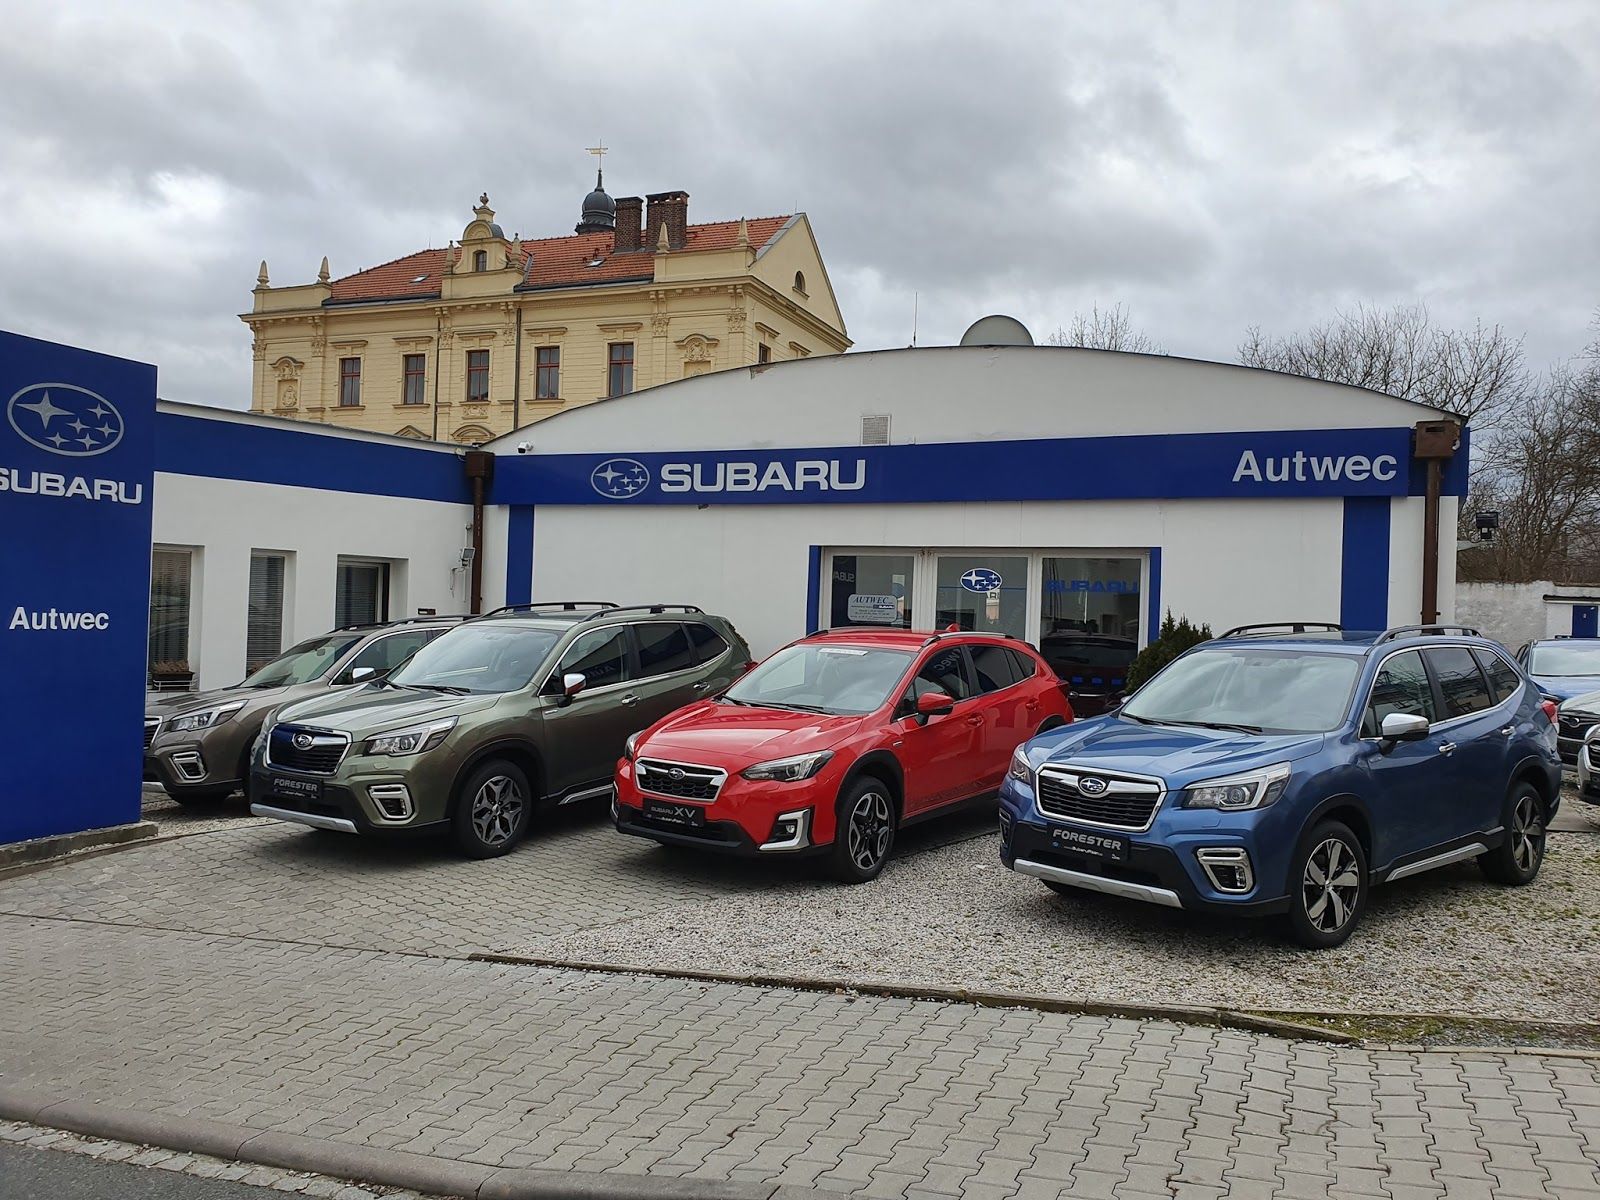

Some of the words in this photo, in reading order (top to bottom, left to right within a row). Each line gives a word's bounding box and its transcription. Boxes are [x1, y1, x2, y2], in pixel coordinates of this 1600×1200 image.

[660, 459, 866, 492] SUBARU
[1232, 450, 1398, 482] Autwec
[852, 596, 889, 604] AUTWEC
[8, 606, 110, 631] Autwec
[273, 778, 318, 792] FORESTER
[674, 806, 696, 818] XV
[1052, 829, 1122, 850] FORESTER
